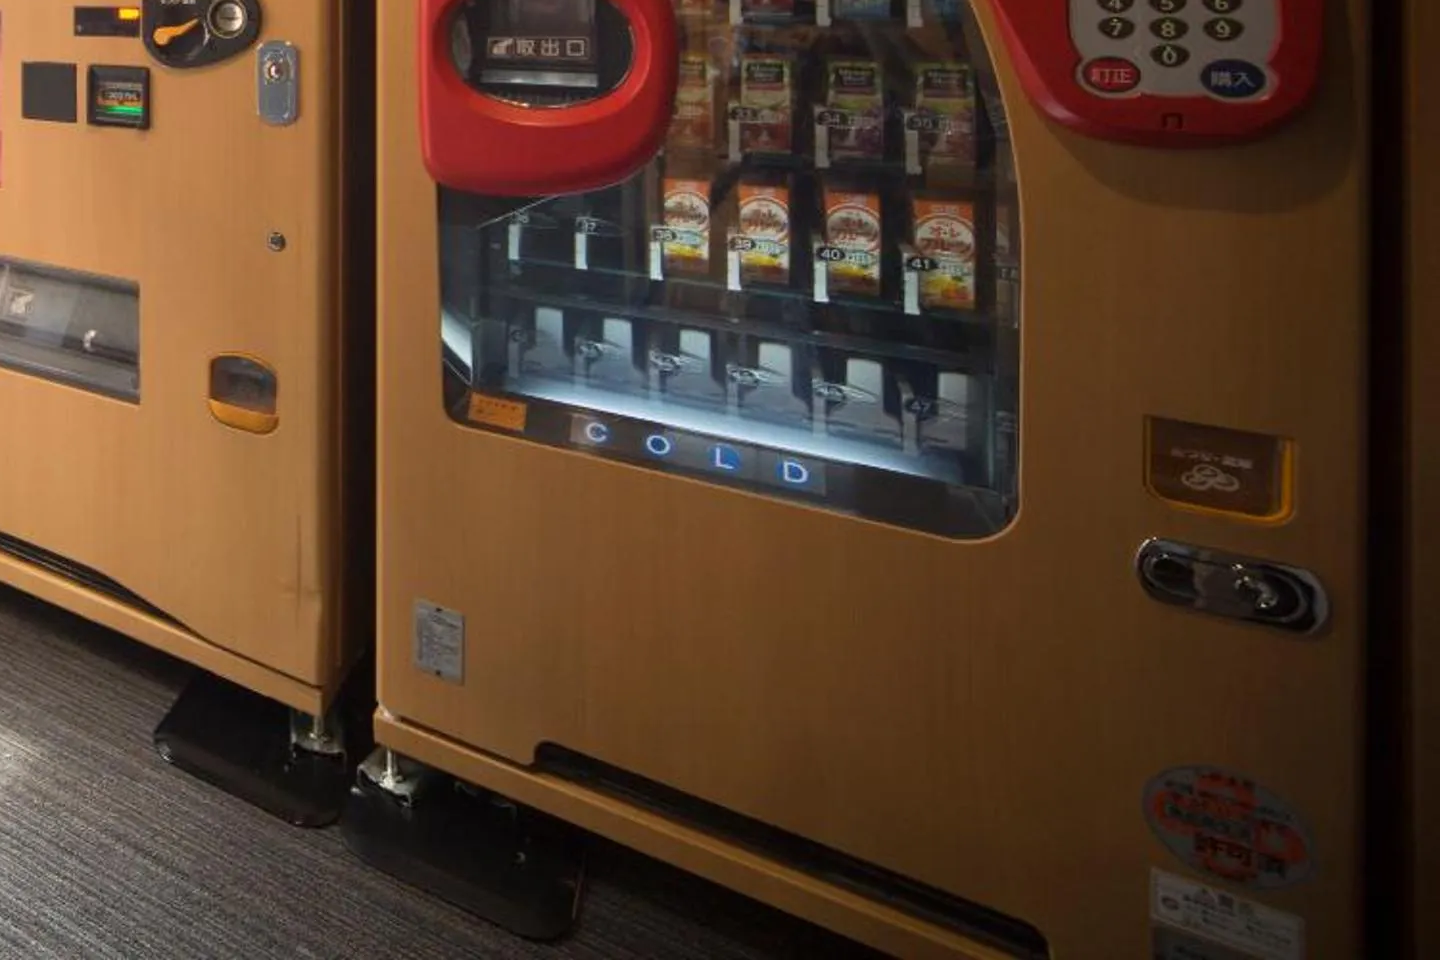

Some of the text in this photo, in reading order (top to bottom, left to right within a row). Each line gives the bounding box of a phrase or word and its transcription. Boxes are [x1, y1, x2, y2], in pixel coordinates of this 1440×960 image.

[1110, 17, 1229, 38] 7 8 9
[516, 38, 585, 57] 取出口
[1161, 44, 1177, 64] 0
[1091, 67, 1134, 84] 訂正
[1210, 69, 1256, 88] 購入
[821, 248, 840, 261] 40
[911, 256, 929, 270] 41
[584, 421, 808, 484] COLD
